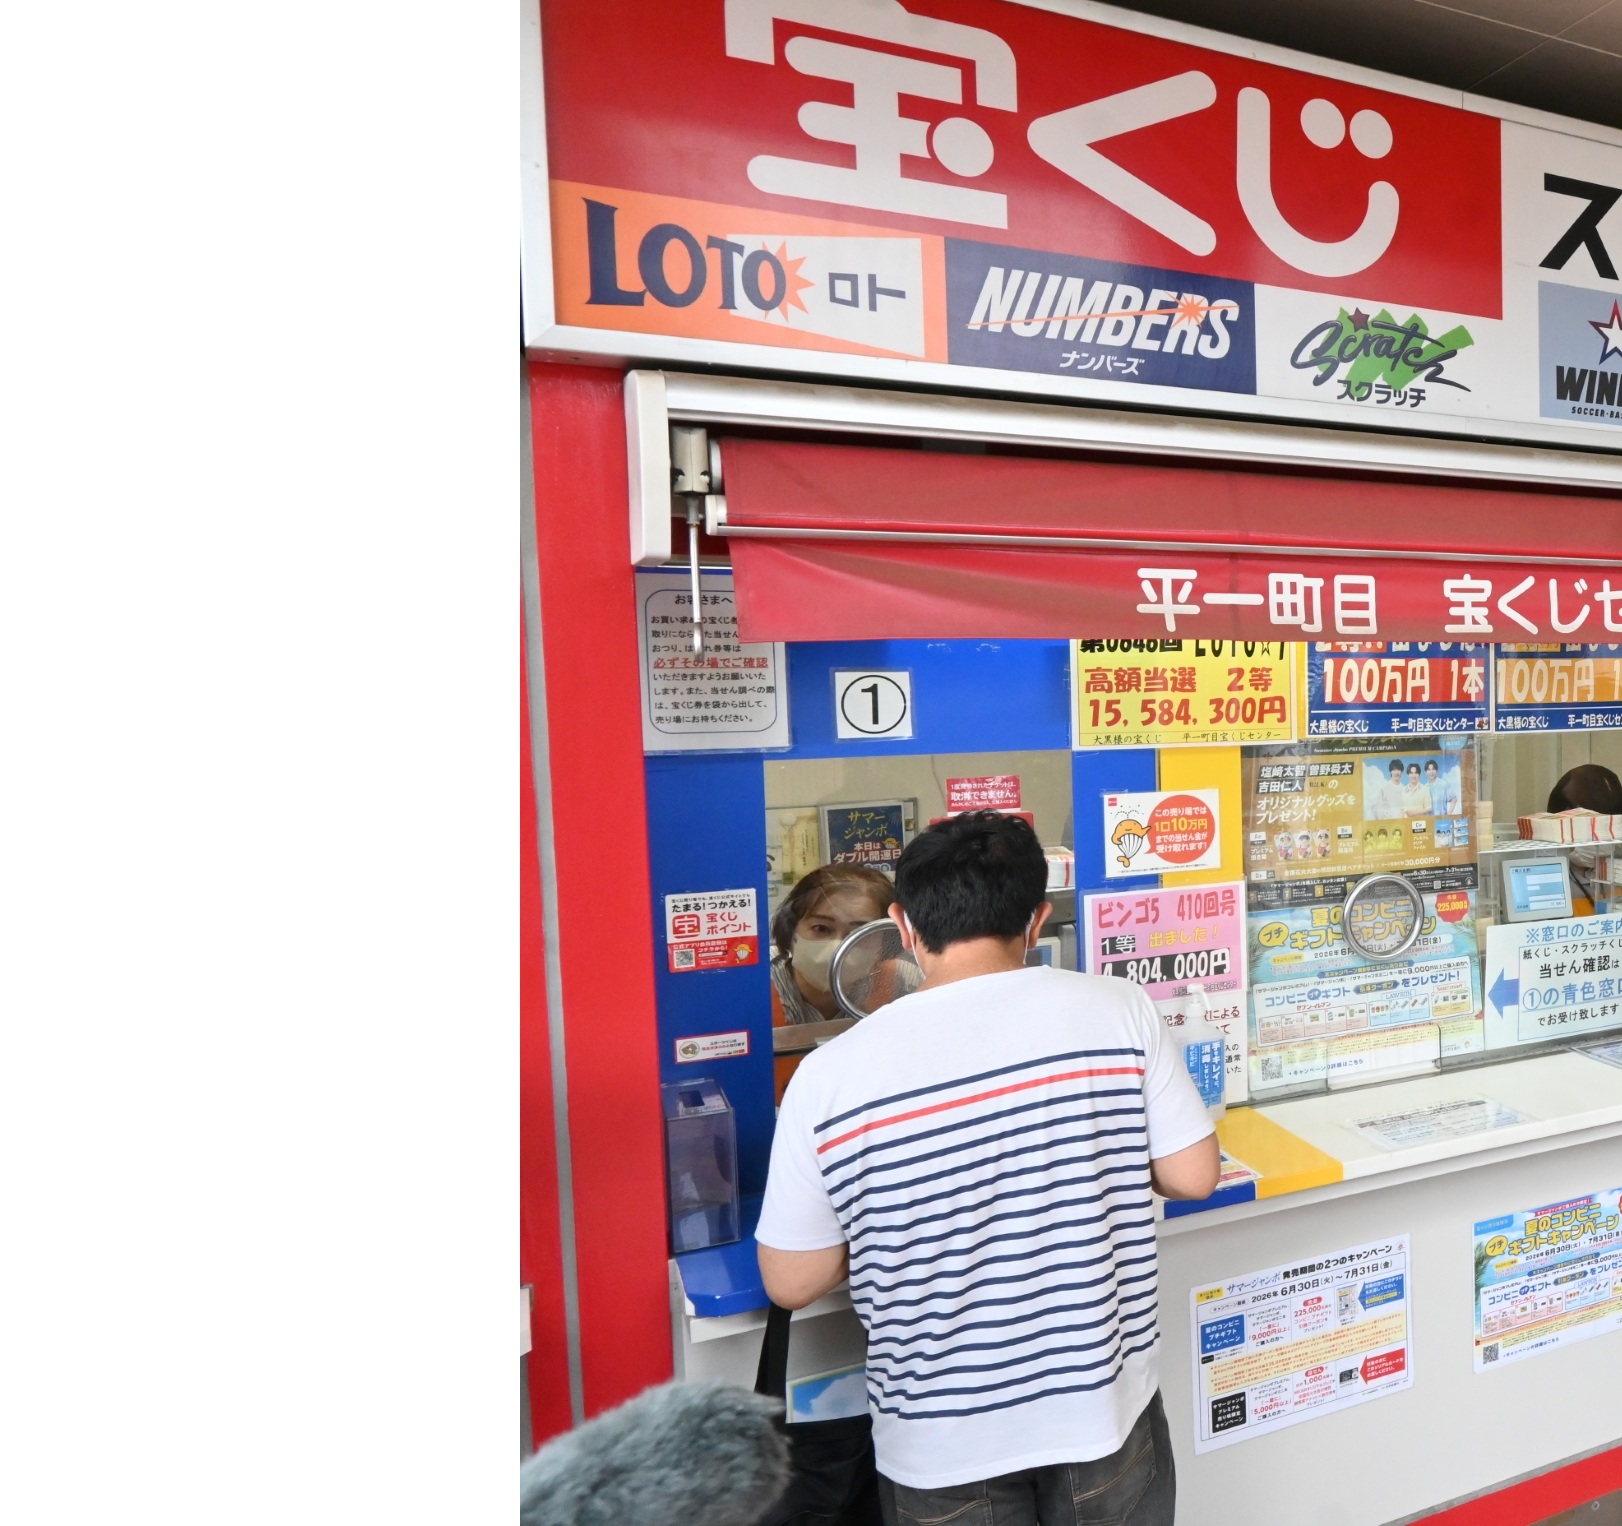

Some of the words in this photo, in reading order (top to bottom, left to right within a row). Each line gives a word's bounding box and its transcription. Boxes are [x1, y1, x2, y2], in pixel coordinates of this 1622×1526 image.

[725, 0, 1399, 277] 宝くじ
[582, 198, 787, 311] LOTO
[829, 271, 906, 312] ロト
[968, 266, 1239, 359] NUMBERS
[1060, 350, 1145, 376] ナンバーズ
[1336, 378, 1427, 409] スクラッチ
[1137, 568, 1377, 634] 平一町目
[652, 644, 742, 653] おつり、はれ券等は
[653, 657, 769, 669] 必ずその場でご確認
[653, 672, 767, 682] いただきますようお願いいた
[1084, 667, 1197, 694] 高額当選
[1226, 667, 1273, 692] 2等
[1323, 658, 1430, 703] 100万円
[1451, 658, 1485, 702] 1本
[1497, 658, 1595, 703] 100万円
[1310, 719, 1369, 734] 大黒様の宝くじ
[1391, 716, 1475, 732] 平一町目宝くじセンター
[1498, 716, 1549, 730] 大黒様の宝くじ
[1093, 734, 1161, 745] 大黒様の宝くじ
[1182, 732, 1281, 743] 平一町目宝くじセンター
[1258, 780, 1302, 793] 吉田仁人
[1257, 793, 1356, 811] オリジナルグッズを
[847, 811, 886, 826] サマー
[1155, 806, 1208, 817] この売り場では
[1256, 809, 1317, 825] プレゼント!
[844, 822, 888, 840] ジャンボ
[1154, 817, 1208, 832] 1口10万円
[853, 841, 881, 850] 本日は
[1155, 832, 1208, 843] までの当せん金が
[833, 849, 902, 864] ダブル開運日
[706, 912, 738, 923] 宝くじ
[1098, 897, 1160, 929] ビンゴ5
[1177, 889, 1236, 921] 410回号
[707, 922, 752, 935] ポイント
[1263, 927, 1284, 942] プチ
[1101, 935, 1136, 955] 1等
[1102, 948, 1230, 985] 4804,000円
[1539, 955, 1620, 979] 当せん確認は
[1537, 1003, 1620, 1026] でお受け致します
[1525, 1203, 1601, 1236] 夏のコンビニ
[1508, 1214, 1620, 1256] ギフトキャンペーン
[1488, 1239, 1504, 1253] プチ
[1251, 1290, 1279, 1303] 2026年
